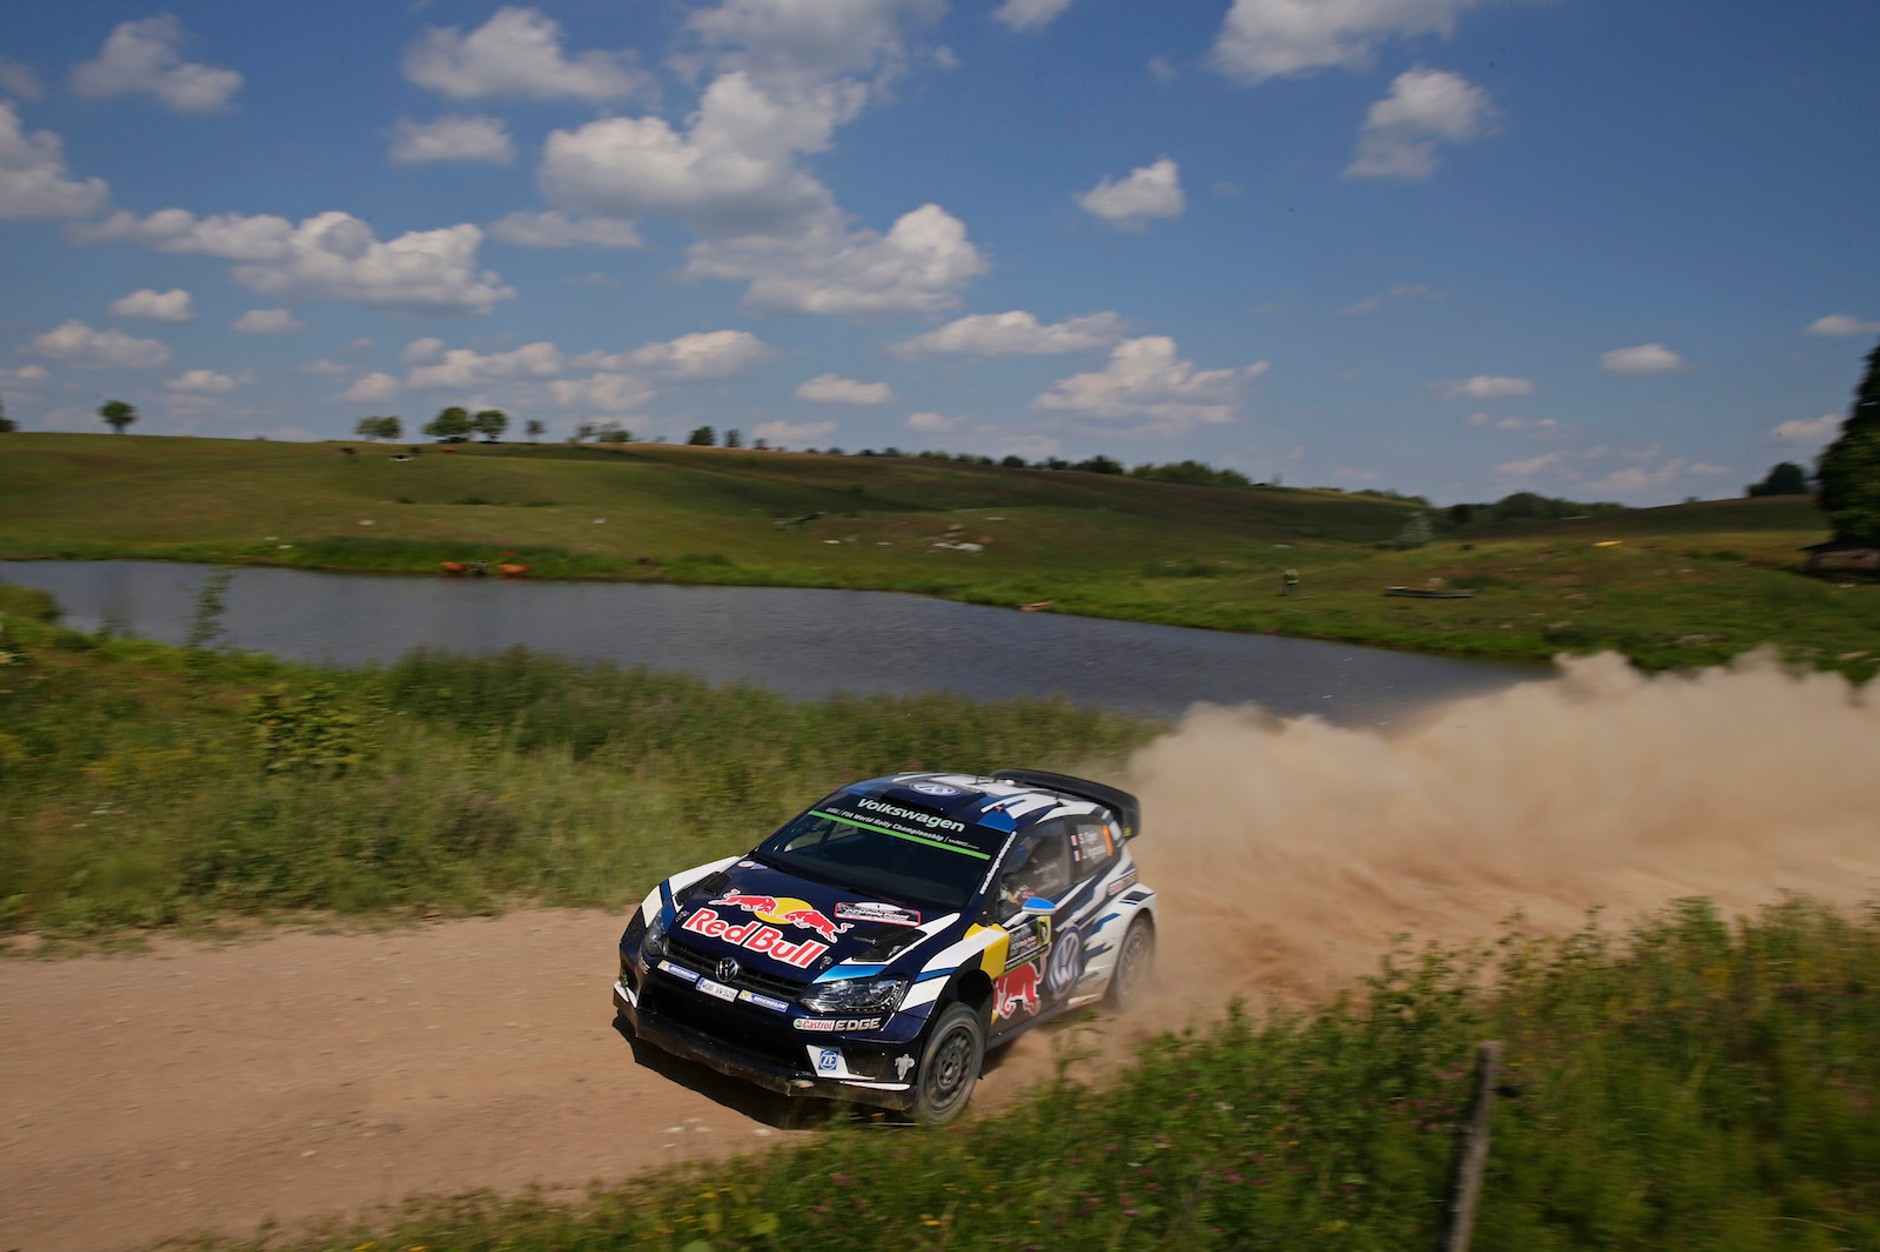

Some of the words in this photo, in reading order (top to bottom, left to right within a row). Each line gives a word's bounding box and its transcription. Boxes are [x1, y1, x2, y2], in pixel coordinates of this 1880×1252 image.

[857, 798, 965, 832] Volkswagen
[853, 813, 875, 823] World
[873, 818, 893, 829] Rally
[892, 823, 945, 841] Championship
[802, 1020, 833, 1031] Castrol
[834, 1017, 882, 1032] EDGE
[821, 1054, 837, 1067] ZF
